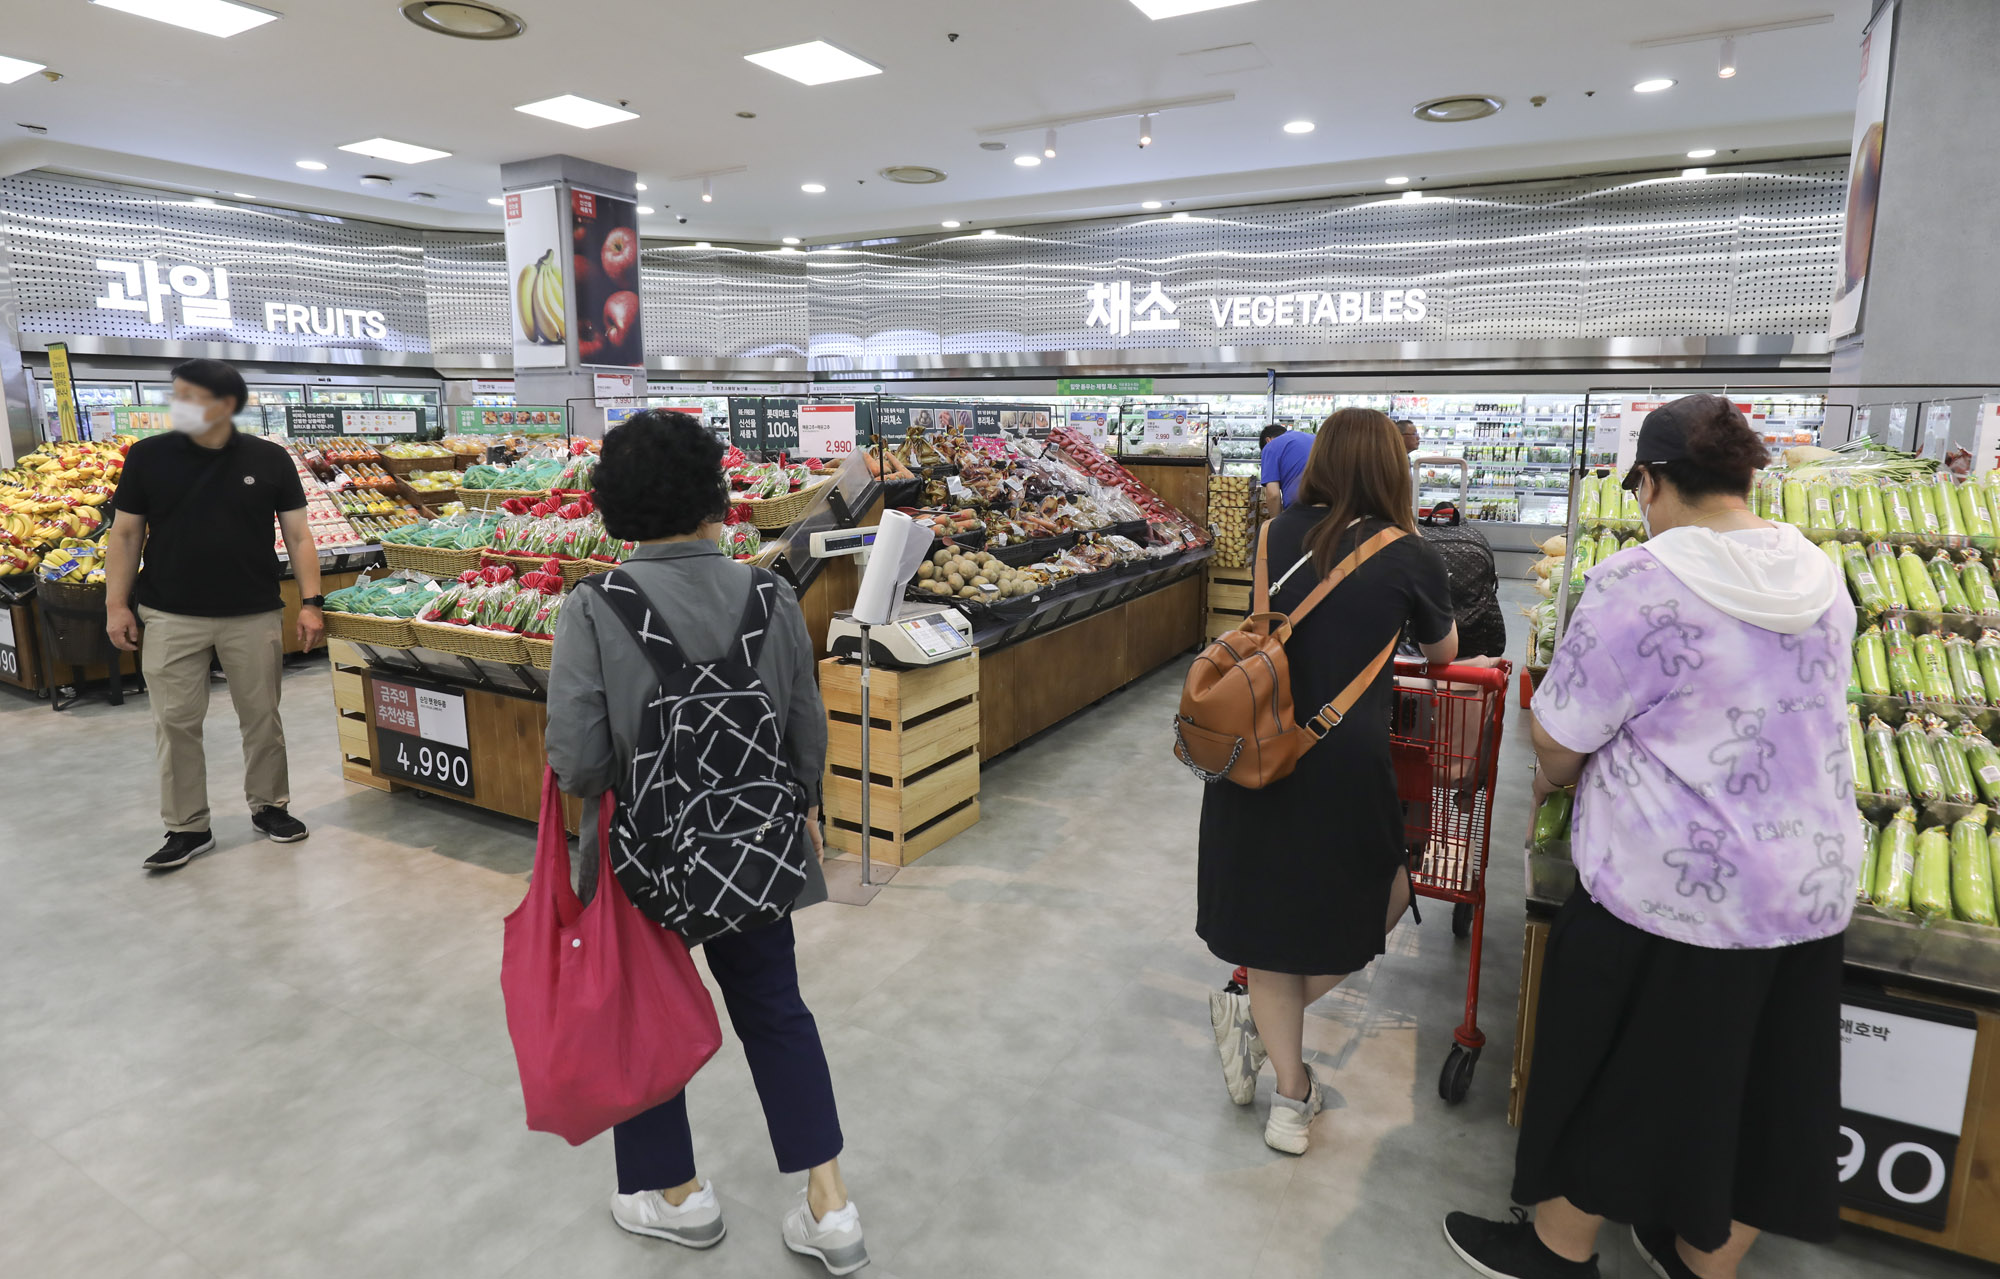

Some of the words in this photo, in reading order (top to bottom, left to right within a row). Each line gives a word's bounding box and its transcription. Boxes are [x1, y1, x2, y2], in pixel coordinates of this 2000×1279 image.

[96, 258, 233, 328] 과일
[1086, 280, 1180, 337] 채소
[1210, 288, 1427, 328] VEGETABLES
[264, 301, 387, 339] FRUITS
[739, 419, 756, 428] 신선을
[767, 409, 791, 419] 롯데마트
[740, 429, 757, 439] 새롭게
[767, 422, 798, 438] 100%
[826, 440, 852, 454] 2,990
[0, 649, 17, 673] 90
[380, 686, 408, 706] 금주의
[378, 705, 416, 728] 추천상품
[397, 742, 469, 787] 4,990
